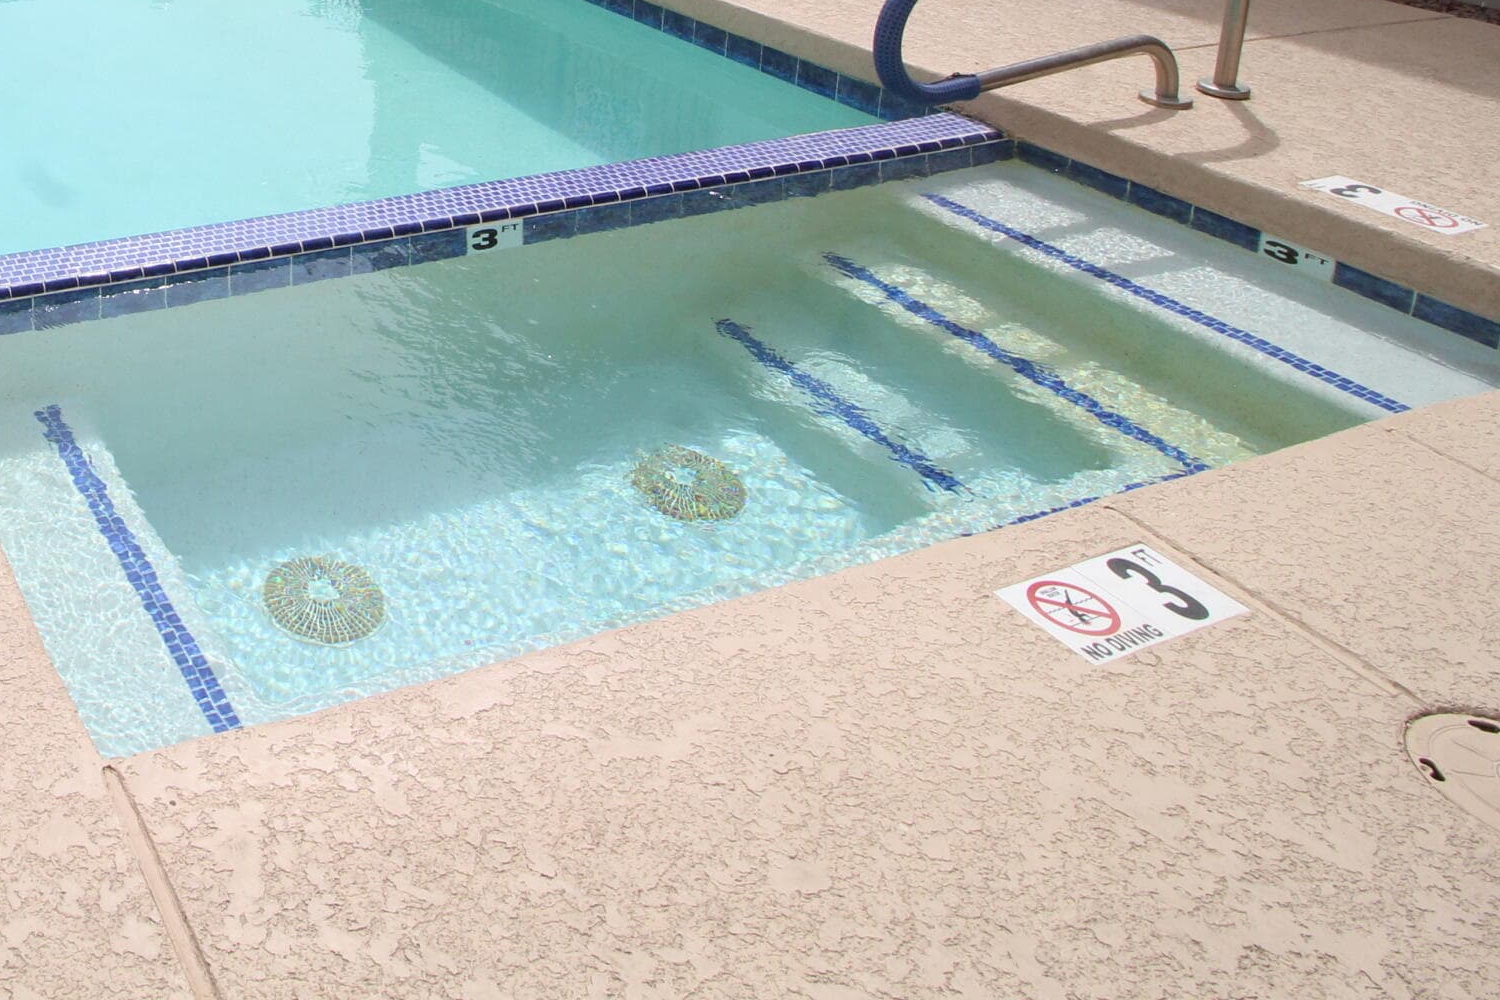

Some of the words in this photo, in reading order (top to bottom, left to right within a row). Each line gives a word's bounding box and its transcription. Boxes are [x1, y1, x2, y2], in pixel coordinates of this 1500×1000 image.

[1330, 184, 1382, 198] 3
[471, 228, 498, 250] 3
[501, 224, 519, 232] FT
[1263, 240, 1299, 265] 3
[1305, 253, 1329, 265] FT
[1130, 548, 1163, 567] FT
[1106, 557, 1210, 620] 3
[1080, 642, 1113, 661] NO
[1105, 624, 1164, 651] DIVING
